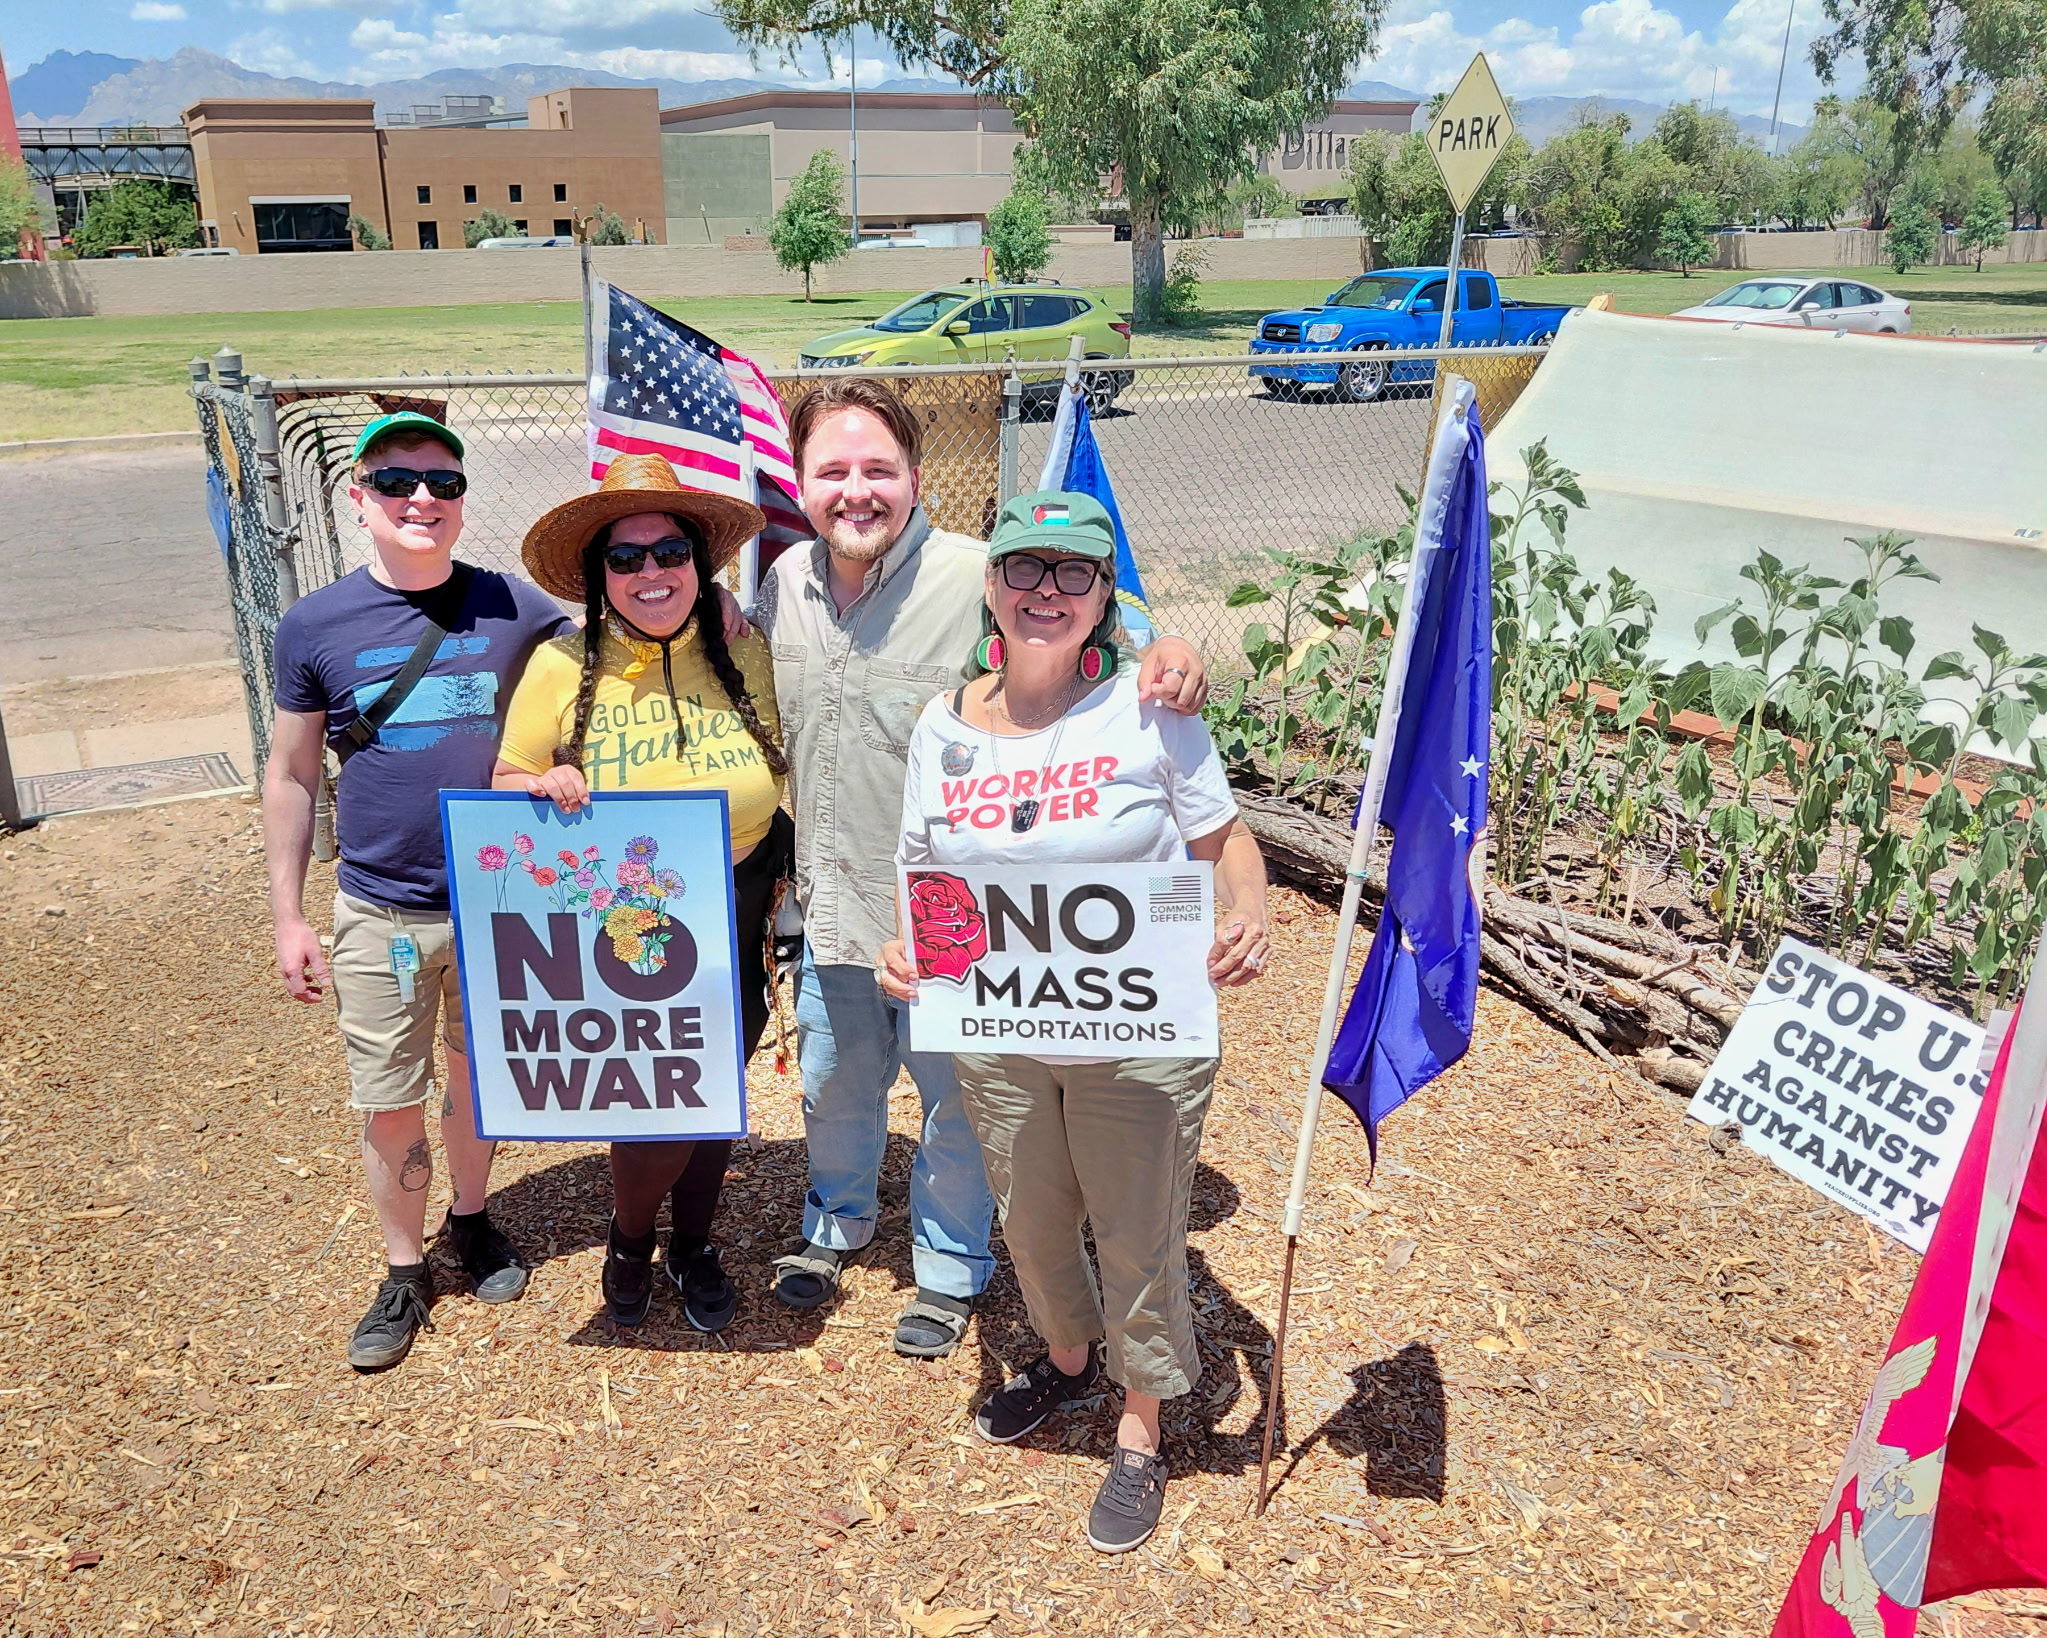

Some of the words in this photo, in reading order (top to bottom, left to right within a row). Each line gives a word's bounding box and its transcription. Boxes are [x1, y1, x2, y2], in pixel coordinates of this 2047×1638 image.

[1438, 114, 1502, 152] PARK
[584, 694, 758, 790] Harves
[941, 756, 1119, 807] WORKER
[984, 883, 1136, 955] NO
[1149, 904, 1202, 914] COMMON
[1150, 912, 1202, 923] DEFENSE
[490, 912, 699, 1002] NO
[974, 966, 1159, 1013] MASS
[1766, 952, 1907, 1042] STOP
[500, 1006, 705, 1054] MORE
[961, 1017, 1177, 1042] DEPORTATIONS
[506, 1056, 709, 1111] WAR
[1773, 1020, 1956, 1136] CRIMES
[1742, 1059, 1940, 1179] AGAINST
[1703, 1077, 1941, 1229] HUMANITY
